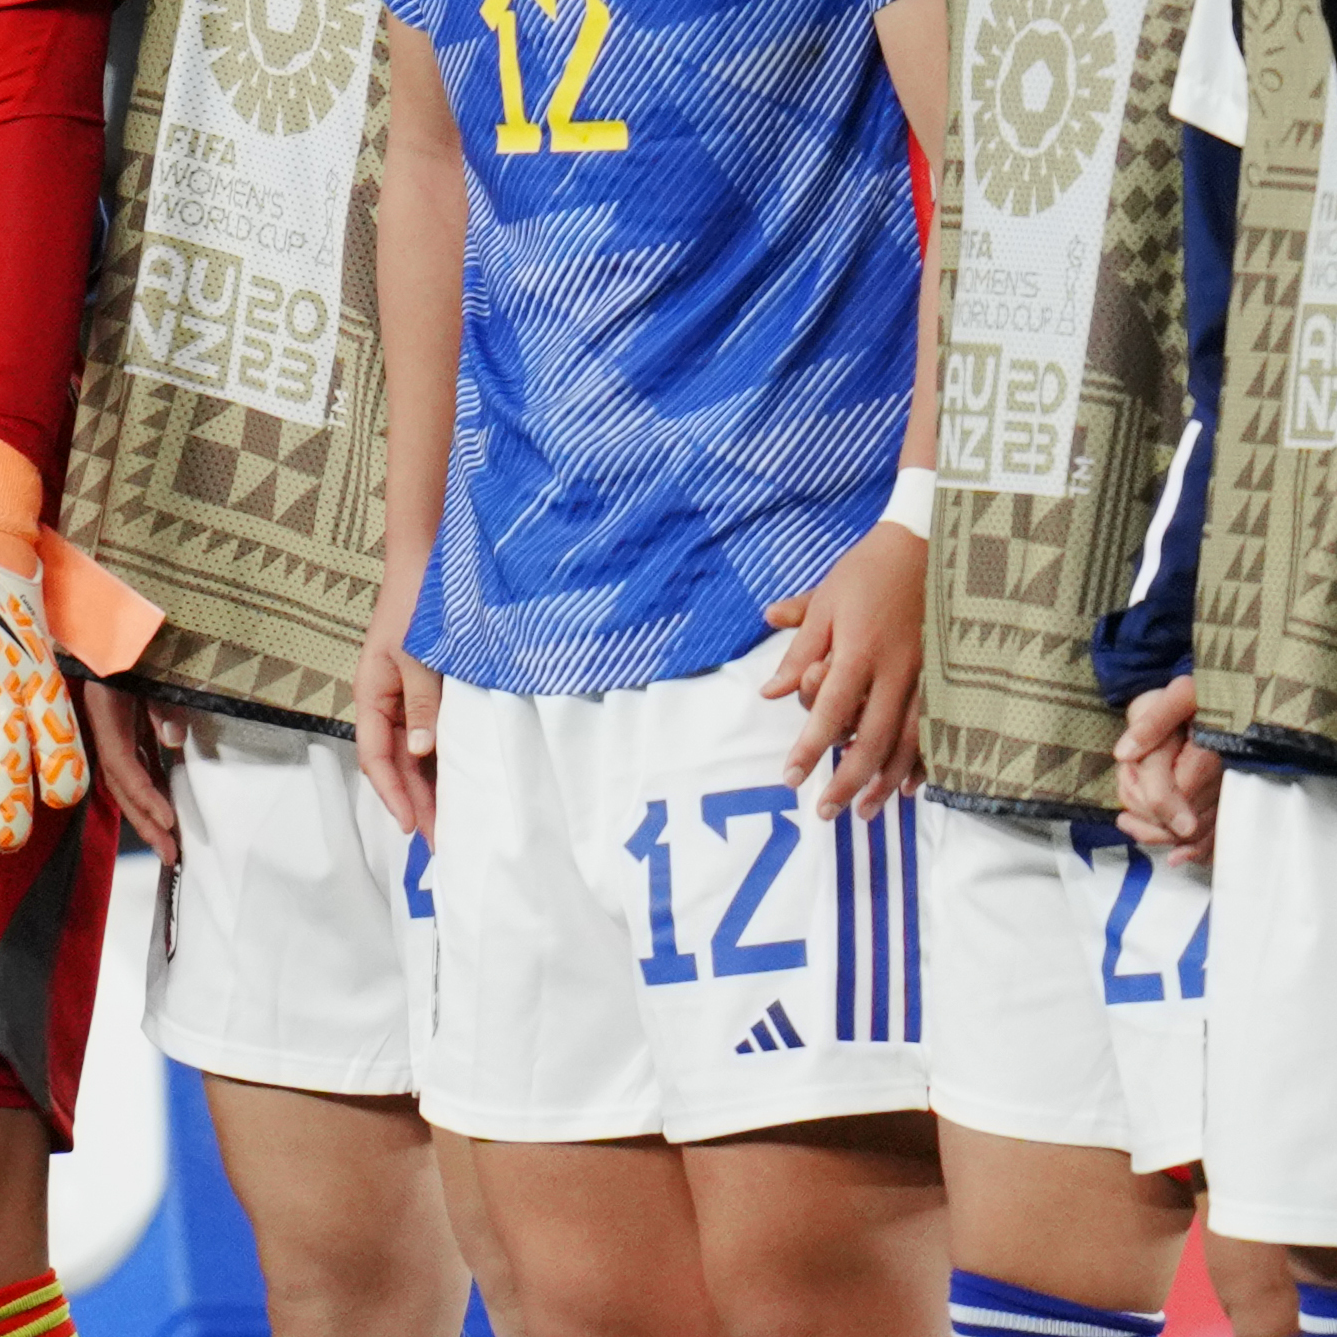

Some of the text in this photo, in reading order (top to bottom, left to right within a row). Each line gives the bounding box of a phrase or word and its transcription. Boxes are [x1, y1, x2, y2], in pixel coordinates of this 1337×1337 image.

[163, 123, 237, 164] FIFA
[159, 158, 285, 222] WOMEN'S
[152, 190, 306, 260] WORLD CUP
[137, 245, 236, 316] AU
[126, 301, 228, 380] NZ
[944, 352, 996, 411] AU
[1007, 358, 1069, 414] 20
[939, 414, 990, 471] NZ
[1002, 420, 1059, 475] 23
[624, 784, 808, 986] 12
